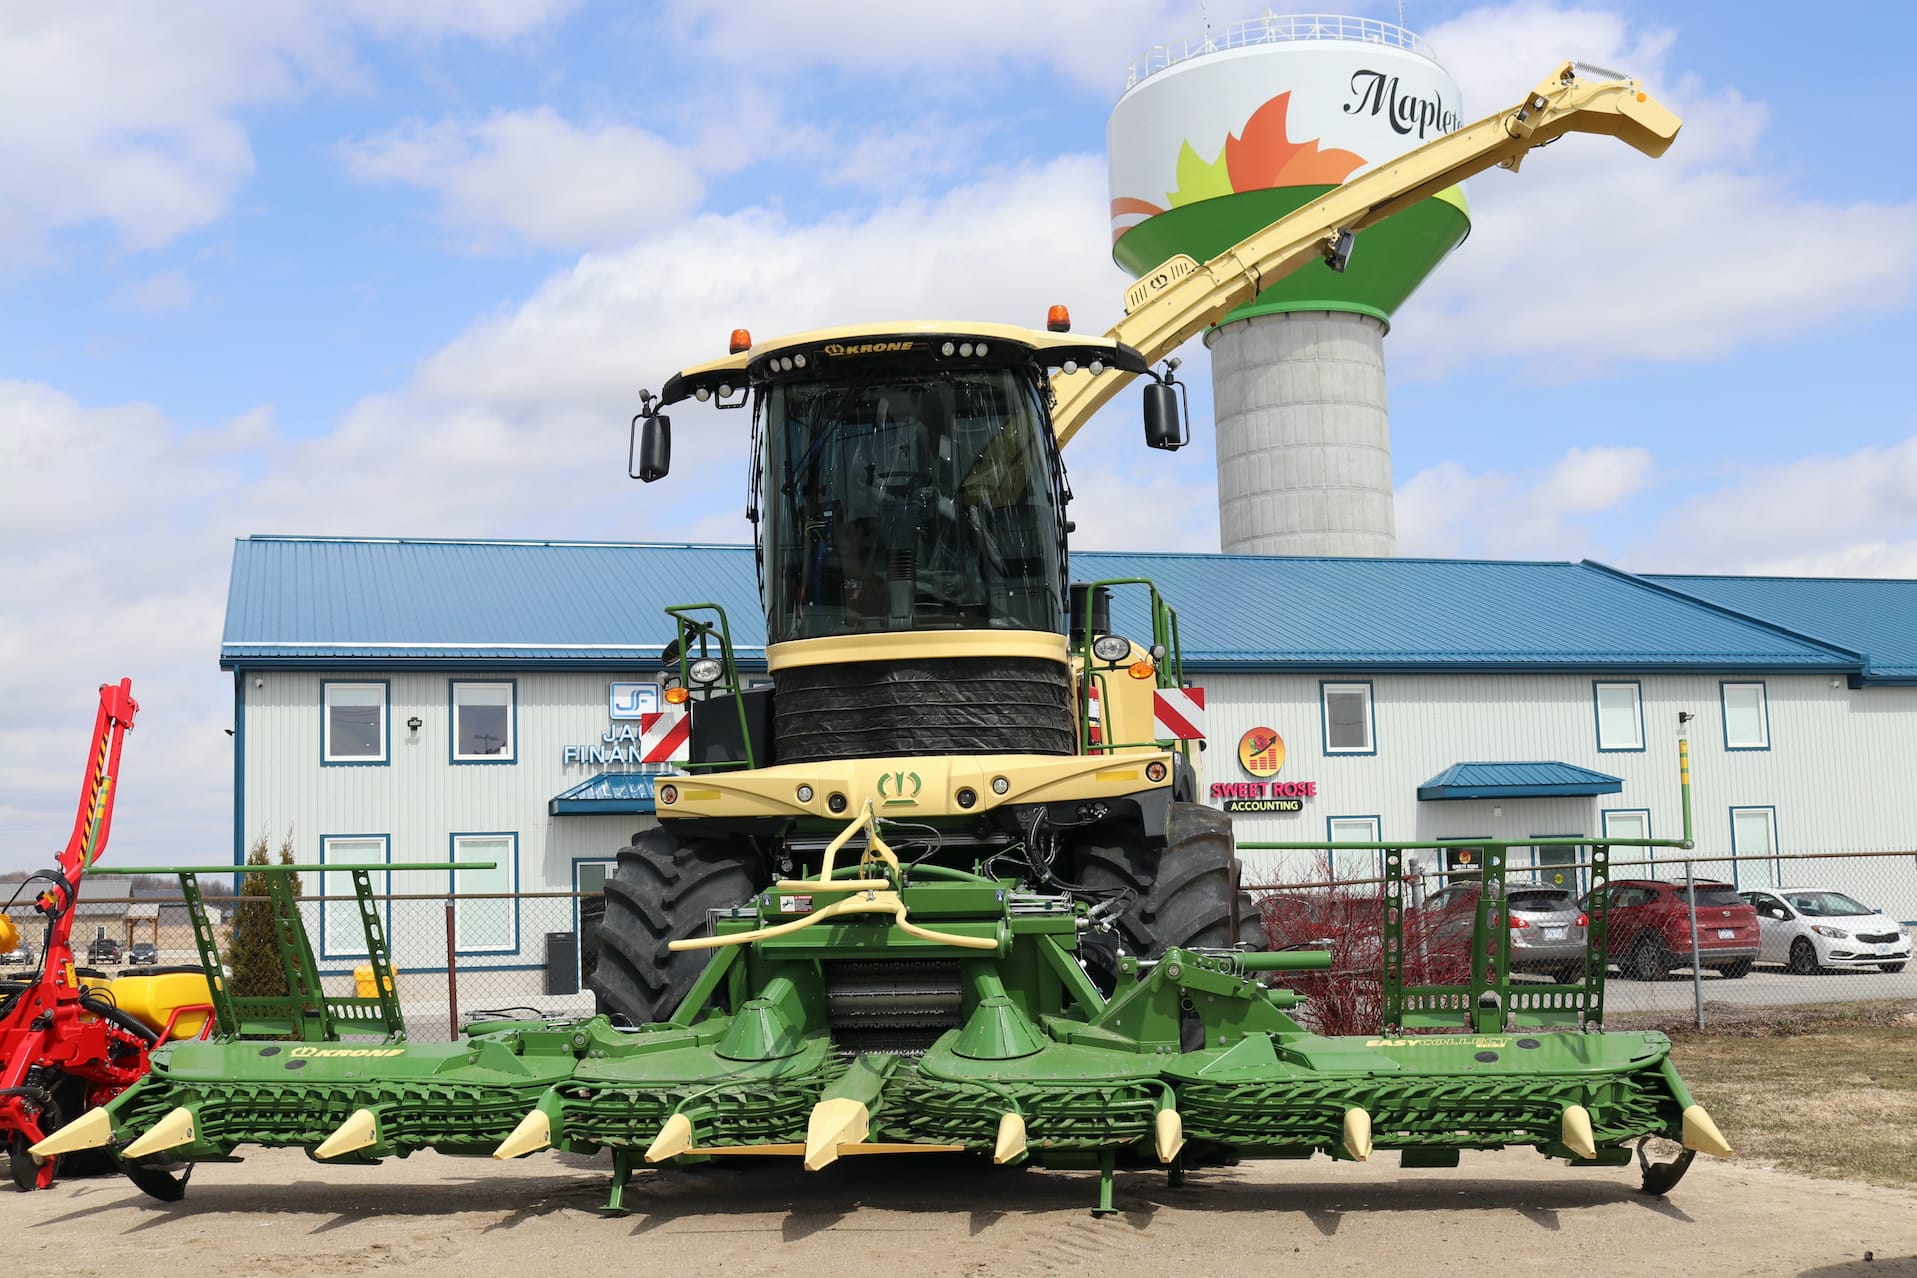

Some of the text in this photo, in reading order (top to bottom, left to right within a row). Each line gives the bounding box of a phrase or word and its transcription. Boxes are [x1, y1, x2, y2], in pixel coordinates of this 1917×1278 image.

[846, 341, 913, 354] KRONE
[1211, 781, 1317, 798] SWEET ROSE
[1231, 801, 1298, 811] ACCOUNTING
[314, 1049, 405, 1057] KRONE
